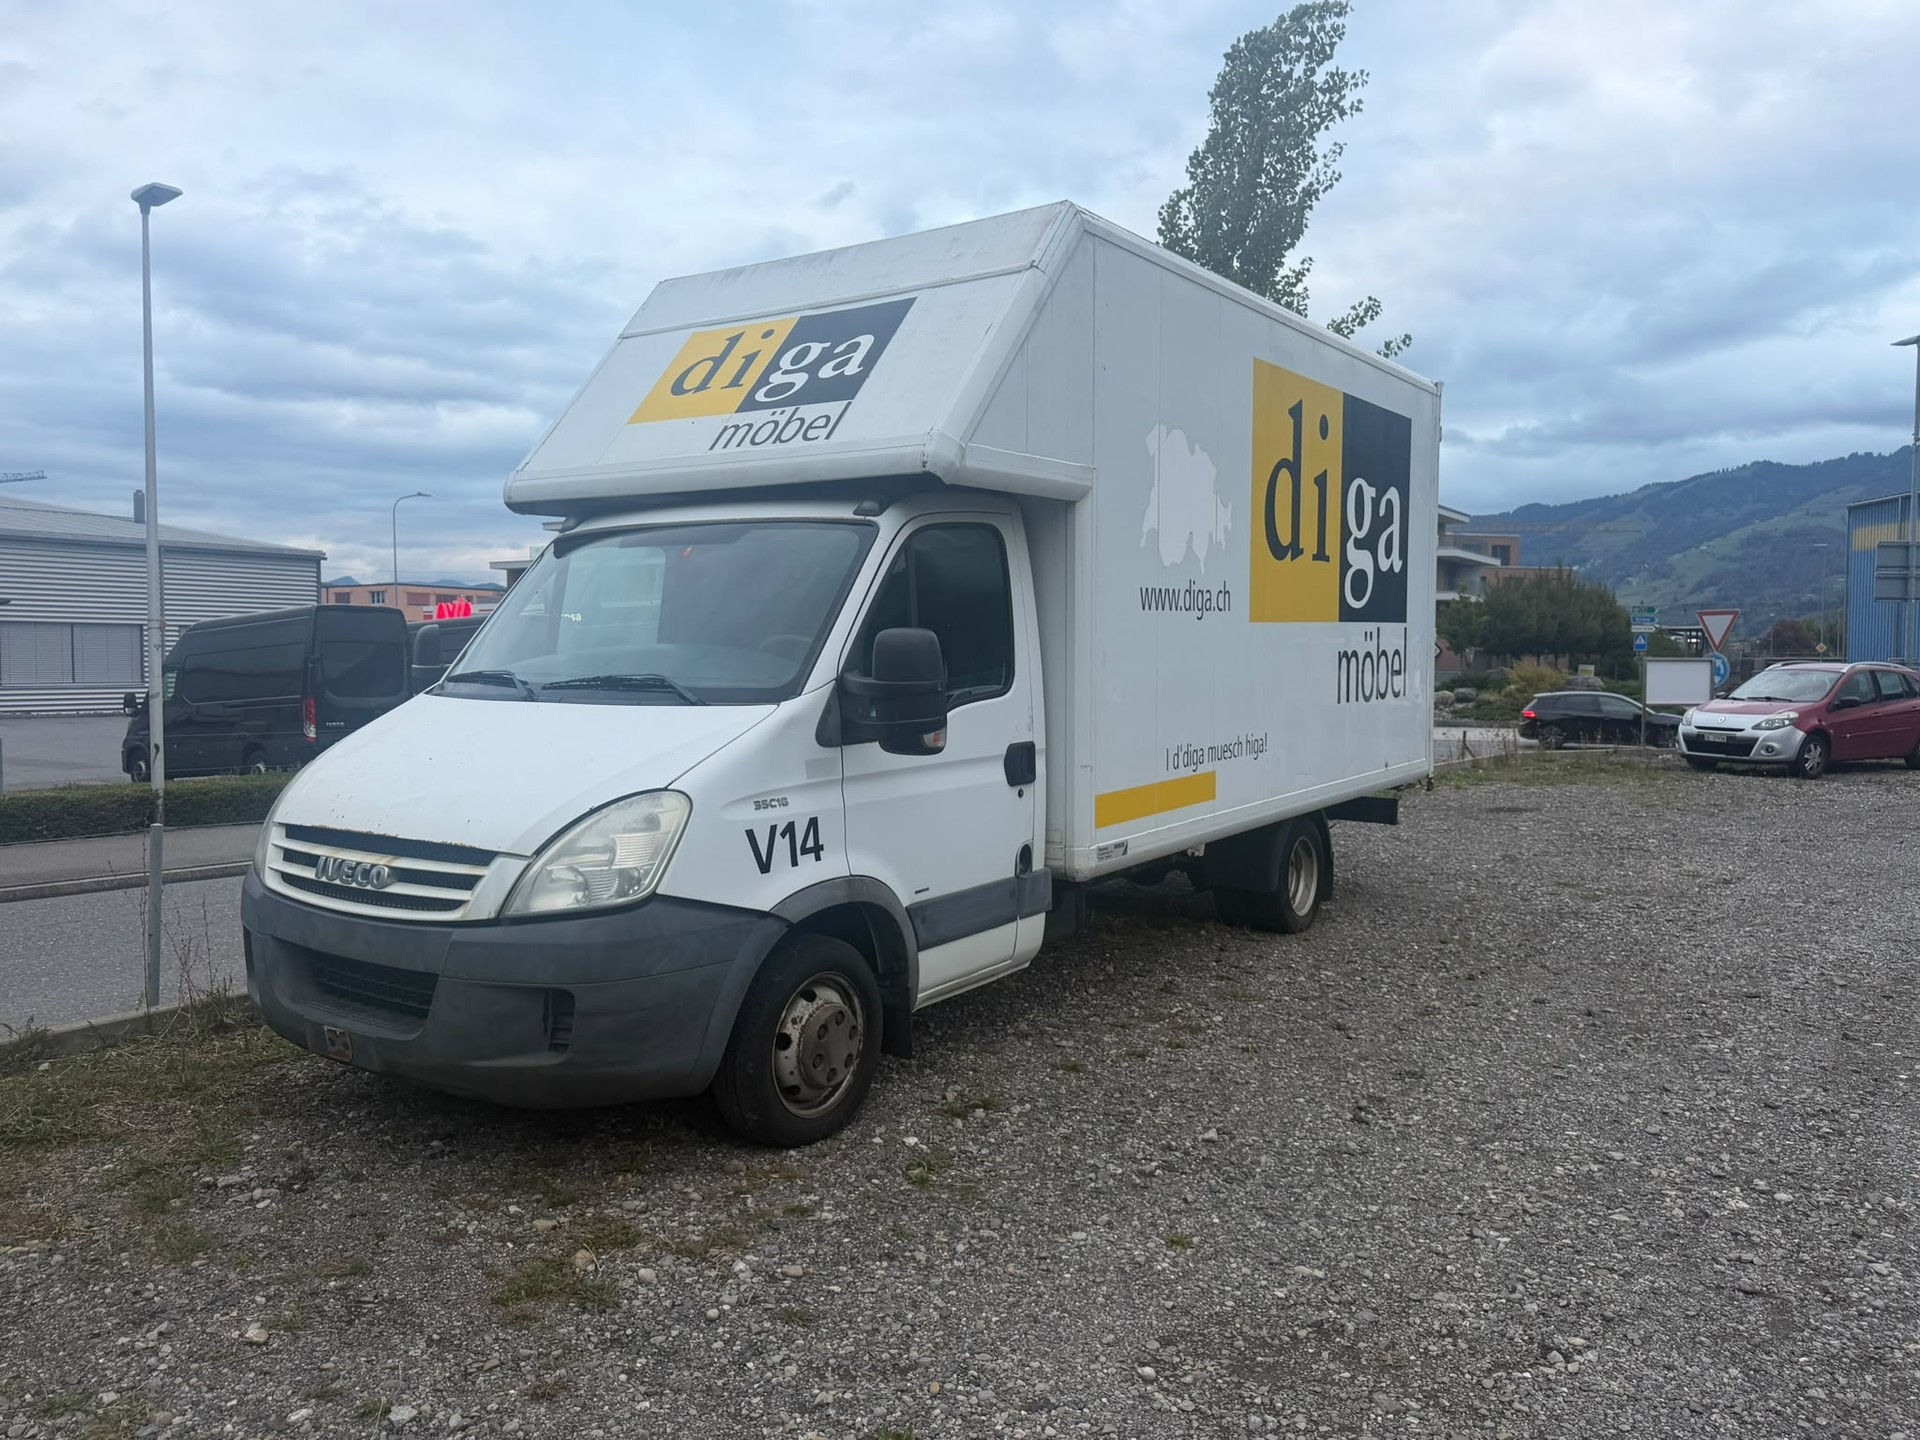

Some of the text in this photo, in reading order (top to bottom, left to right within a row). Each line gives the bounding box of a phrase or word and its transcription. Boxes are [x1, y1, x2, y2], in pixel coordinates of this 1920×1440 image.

[670, 328, 875, 402] diga
[708, 401, 852, 451] möbel
[1264, 399, 1403, 609] diga
[1140, 578, 1230, 620] www.diga.ch
[1338, 627, 1407, 704] möbel
[1173, 743, 1204, 772] d'diga
[1208, 735, 1243, 763] muesch
[1246, 732, 1268, 760] higa!
[745, 816, 824, 874] V14
[315, 856, 390, 889] IVECO
